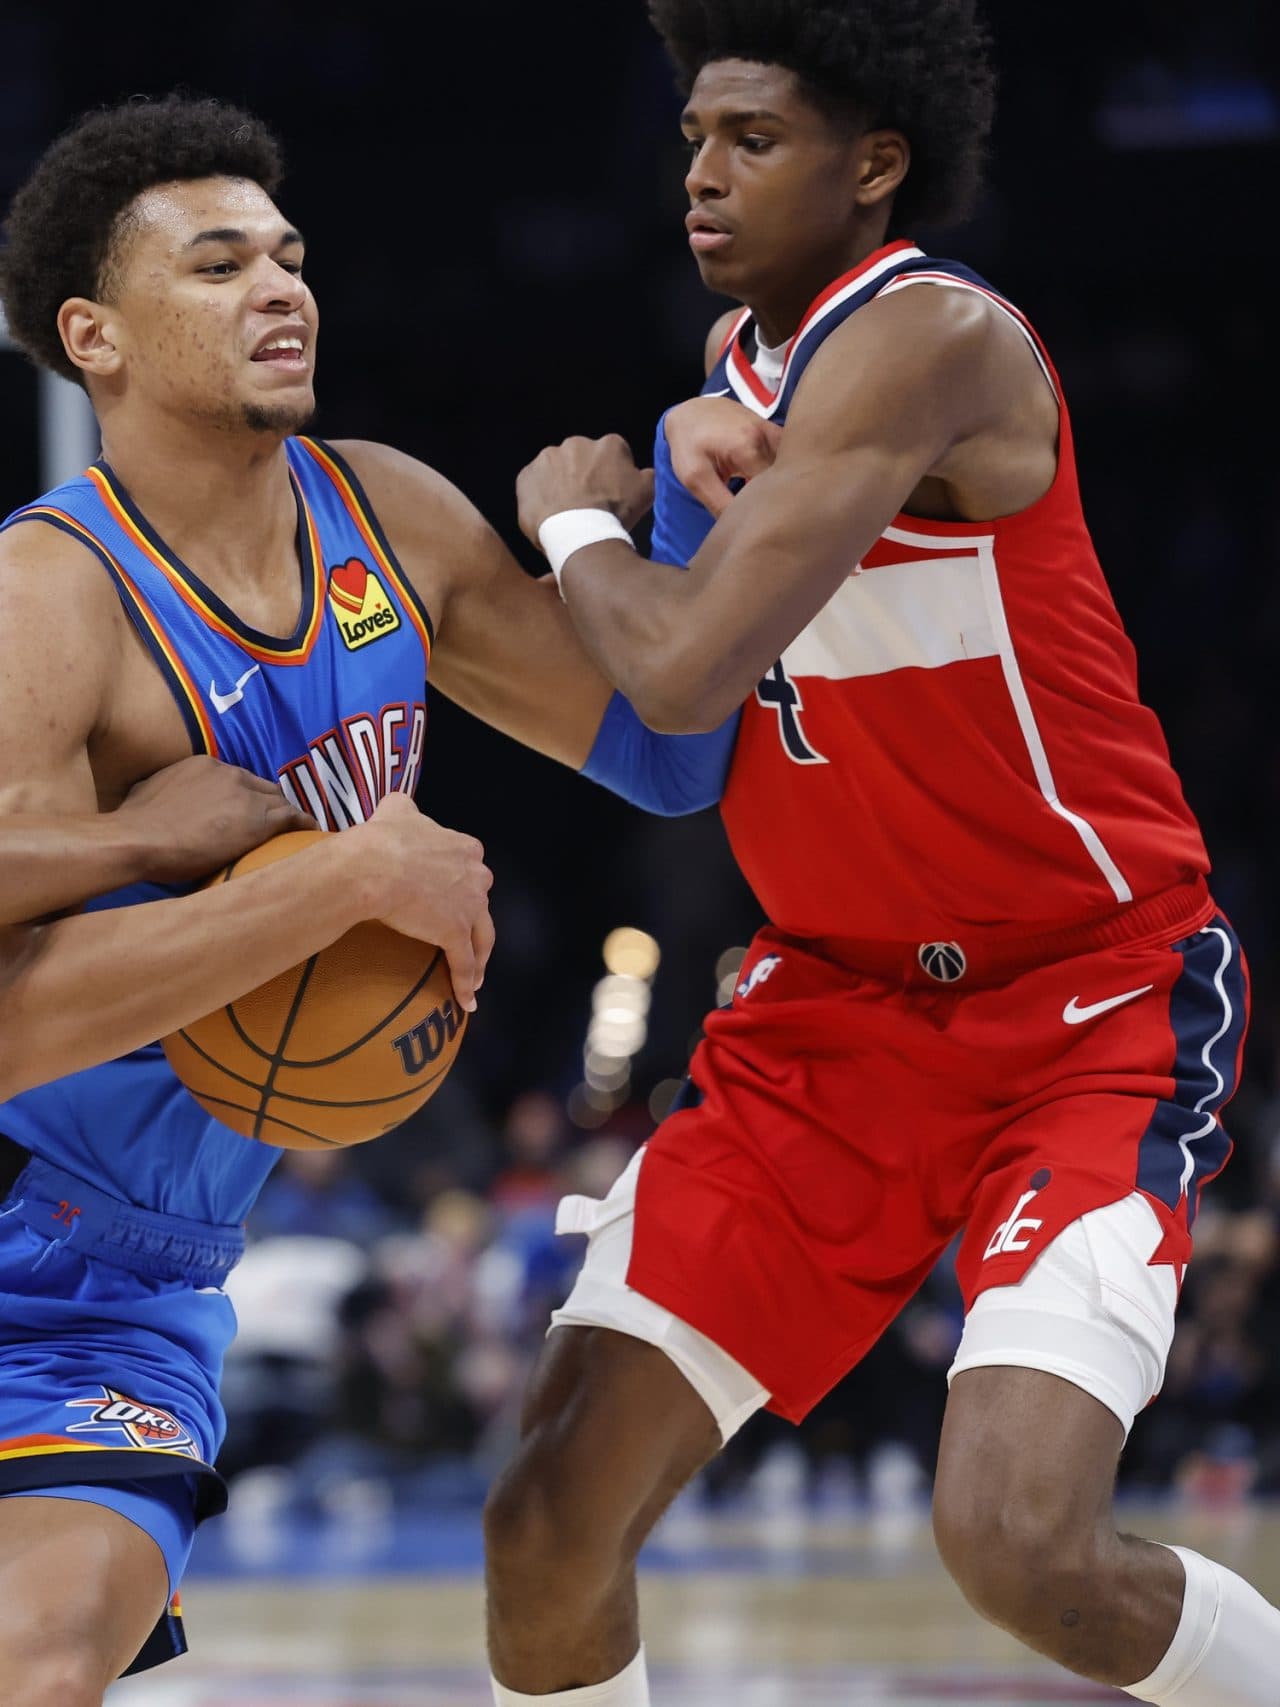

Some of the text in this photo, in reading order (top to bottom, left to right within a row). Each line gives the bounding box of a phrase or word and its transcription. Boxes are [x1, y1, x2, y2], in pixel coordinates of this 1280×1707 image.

[342, 602, 395, 644] Love's
[277, 702, 427, 833] UNDER
[99, 1400, 178, 1433] OKC
